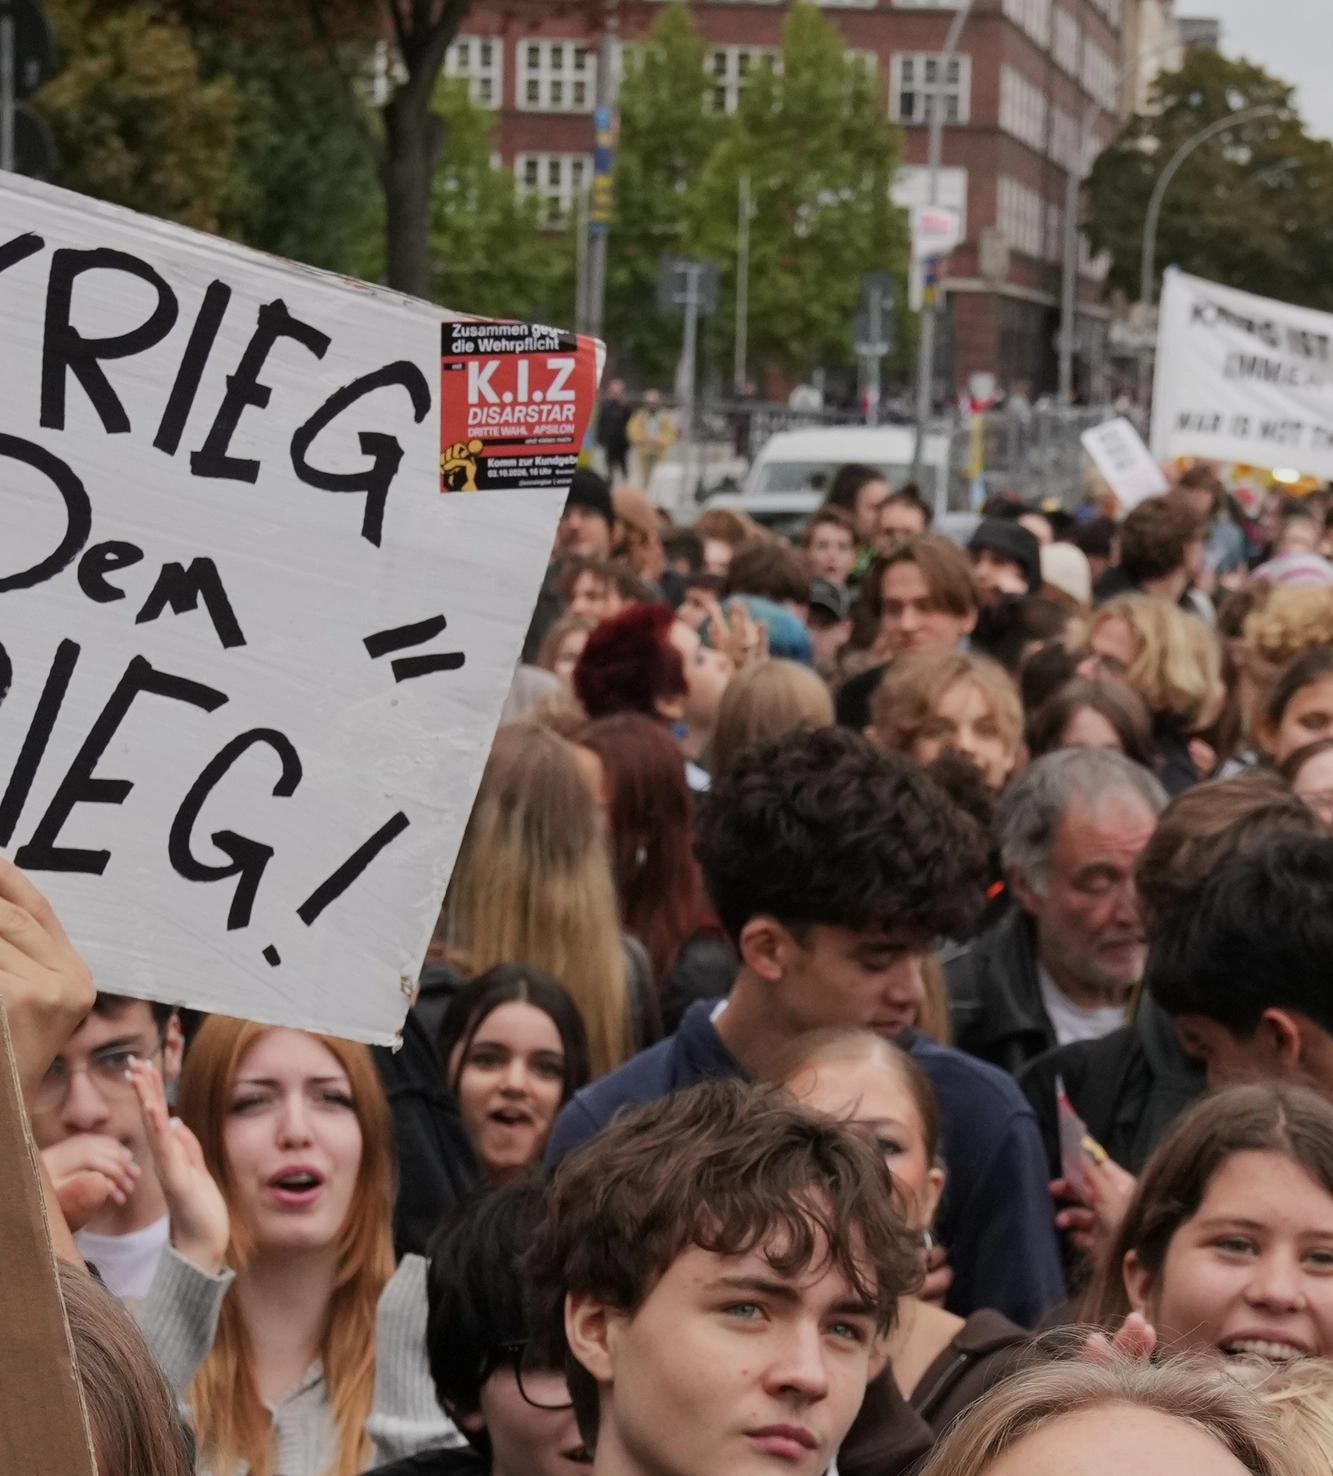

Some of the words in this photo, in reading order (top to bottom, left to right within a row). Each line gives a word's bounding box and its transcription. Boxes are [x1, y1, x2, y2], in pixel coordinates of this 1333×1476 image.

[452, 323, 529, 337] Zusammen
[452, 339, 474, 353] die
[477, 337, 560, 353] Wehrpflicht
[468, 358, 575, 405] K.I.Z
[0, 233, 431, 548] RIEG
[468, 405, 575, 425] DISARSTAR
[468, 426, 500, 438] DRITTE
[501, 425, 529, 436] WAHL
[533, 423, 575, 434] APSILON
[487, 458, 517, 468] Komm
[518, 458, 533, 467] zur
